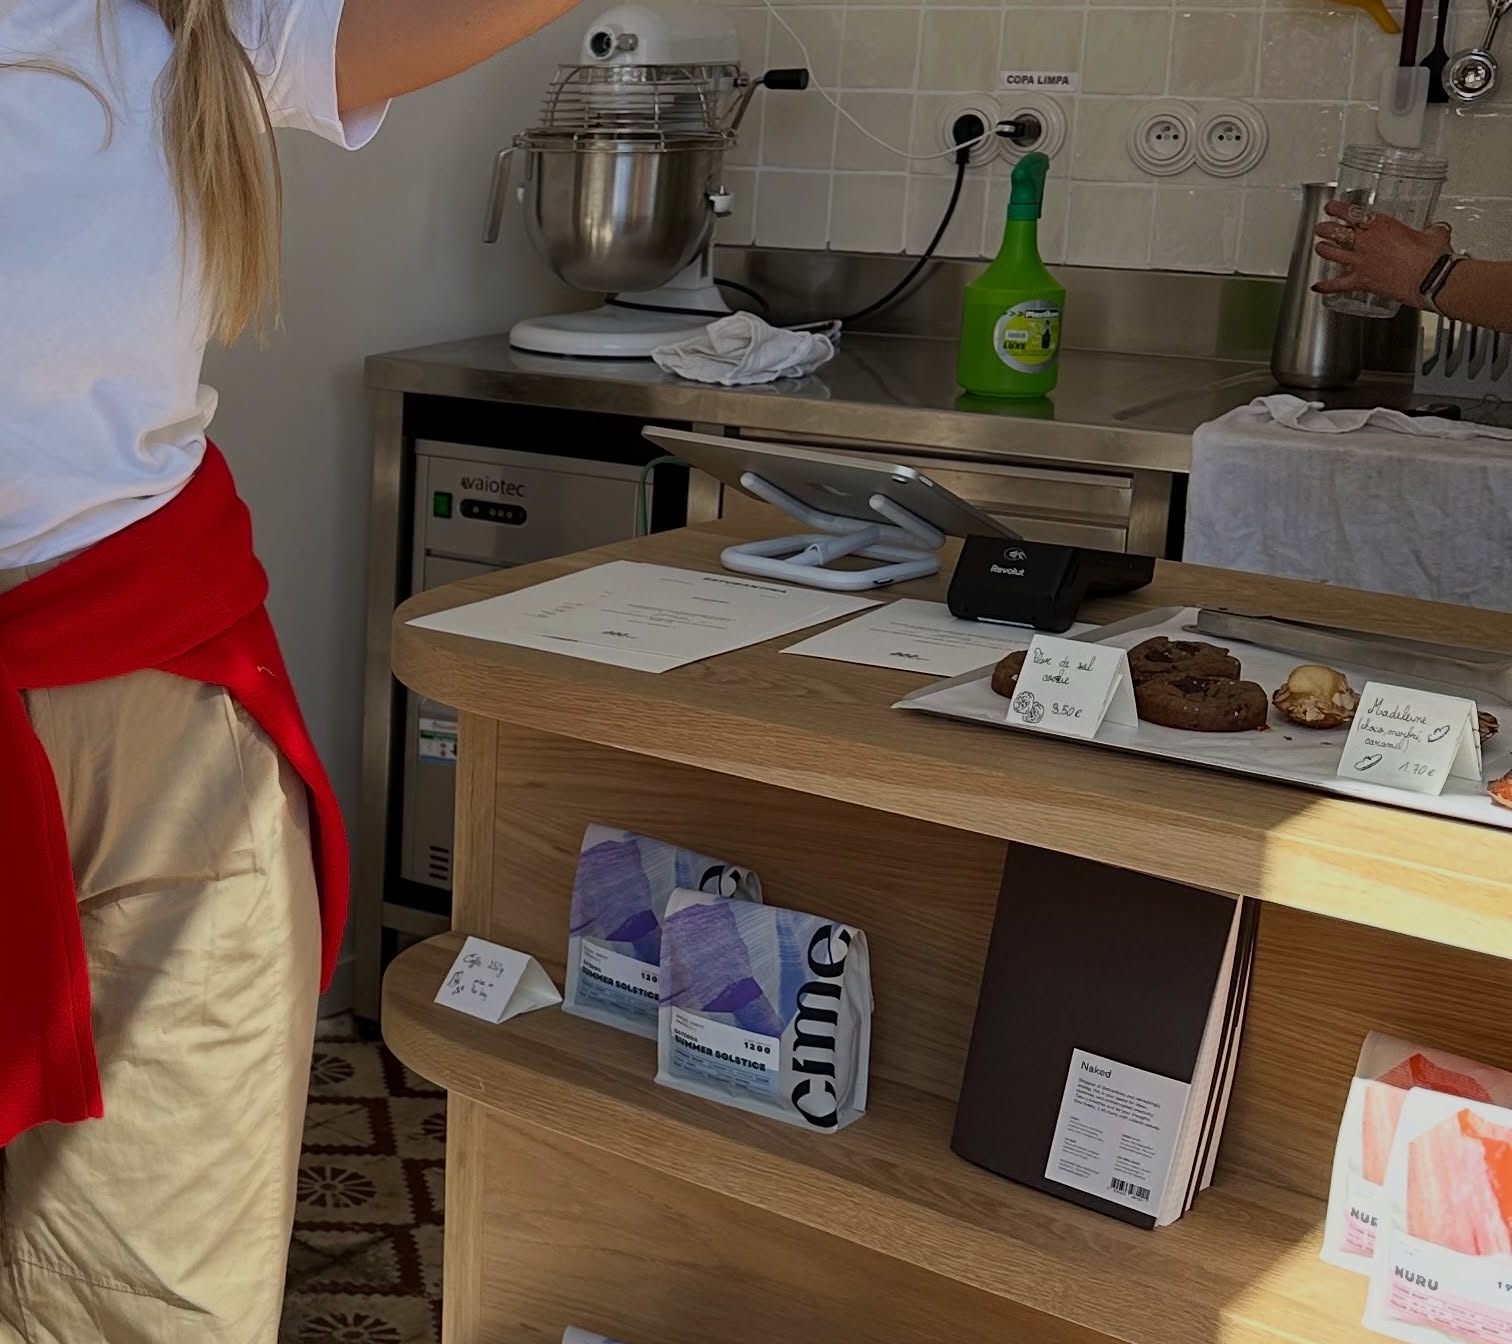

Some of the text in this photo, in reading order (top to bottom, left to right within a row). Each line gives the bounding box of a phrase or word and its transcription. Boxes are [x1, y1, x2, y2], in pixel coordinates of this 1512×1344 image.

[1006, 74, 1070, 85] COPA LIMPA
[990, 564, 1025, 576] Revolut
[1368, 697, 1427, 724] Madeleine
[641, 972, 658, 983] 120
[615, 980, 660, 1001] SOLSTICE
[791, 924, 852, 1128] cime
[674, 1034, 713, 1056] SUMMER
[714, 1050, 766, 1072] SOLSTICE
[743, 1041, 771, 1054] 1200
[1080, 1060, 1112, 1078] Naked
[1350, 1207, 1378, 1227] NUR
[1395, 1265, 1439, 1291] NURU
